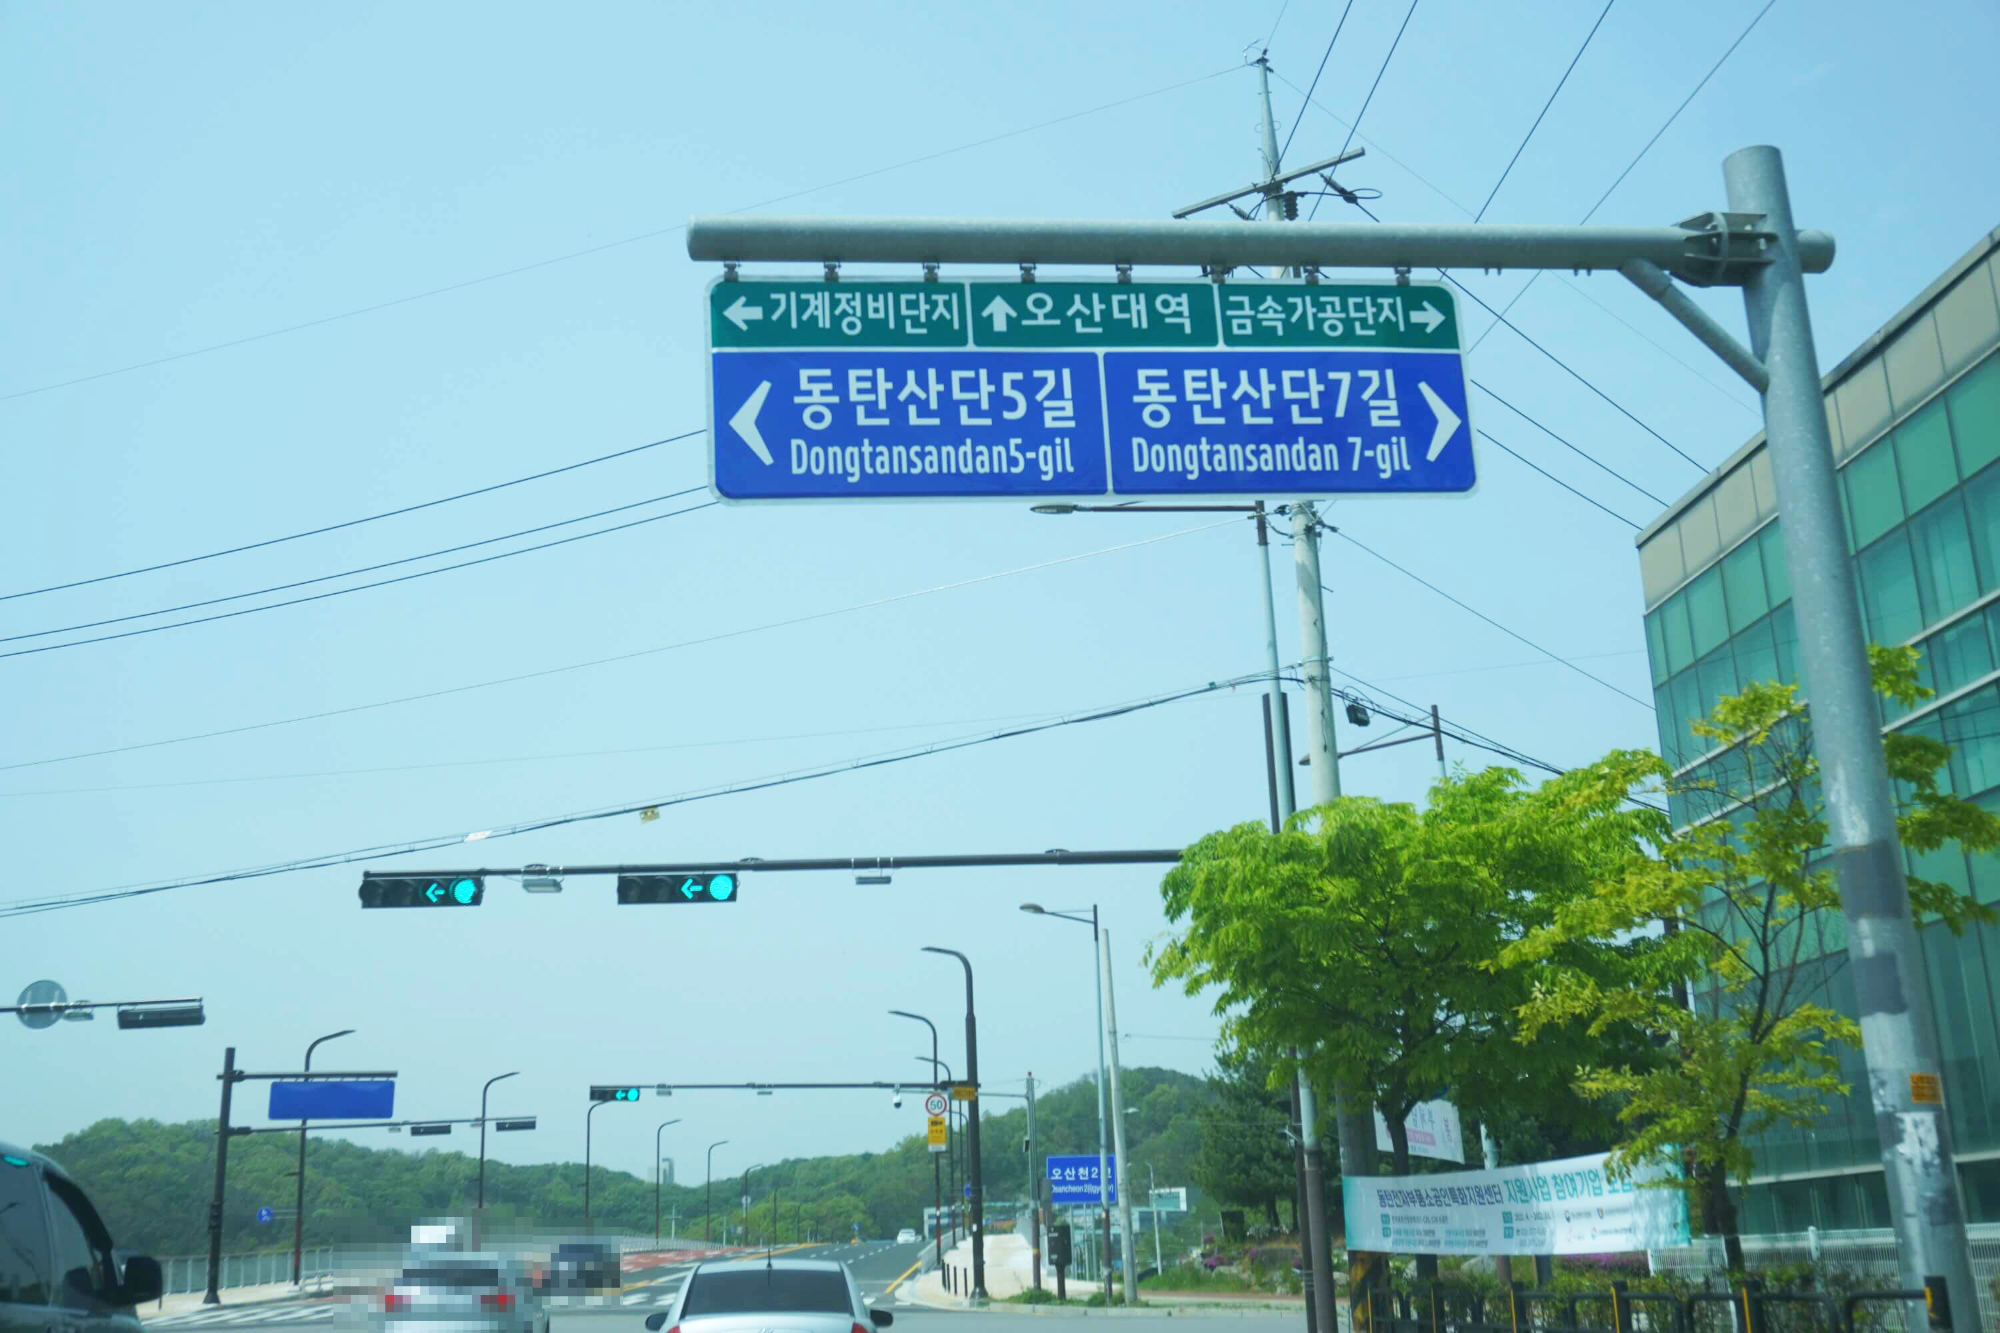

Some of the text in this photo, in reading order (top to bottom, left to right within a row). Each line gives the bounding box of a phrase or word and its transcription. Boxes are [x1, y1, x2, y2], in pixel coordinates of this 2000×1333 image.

[769, 291, 960, 336] 기계정비단지
[1021, 292, 1192, 335] 오산대역
[1226, 295, 1406, 337] 금속가공단지
[793, 367, 1076, 430] 동탄산단5길
[1132, 367, 1401, 429] 동탄산단7길
[790, 437, 1075, 483] Dongtansandan5-gil
[1131, 436, 1412, 480] Dongtansandan 7-gil
[930, 1099, 943, 1111] 50
[1504, 1175, 1552, 1204] 지원사업
[1552, 1168, 1603, 1200] 참여기업
